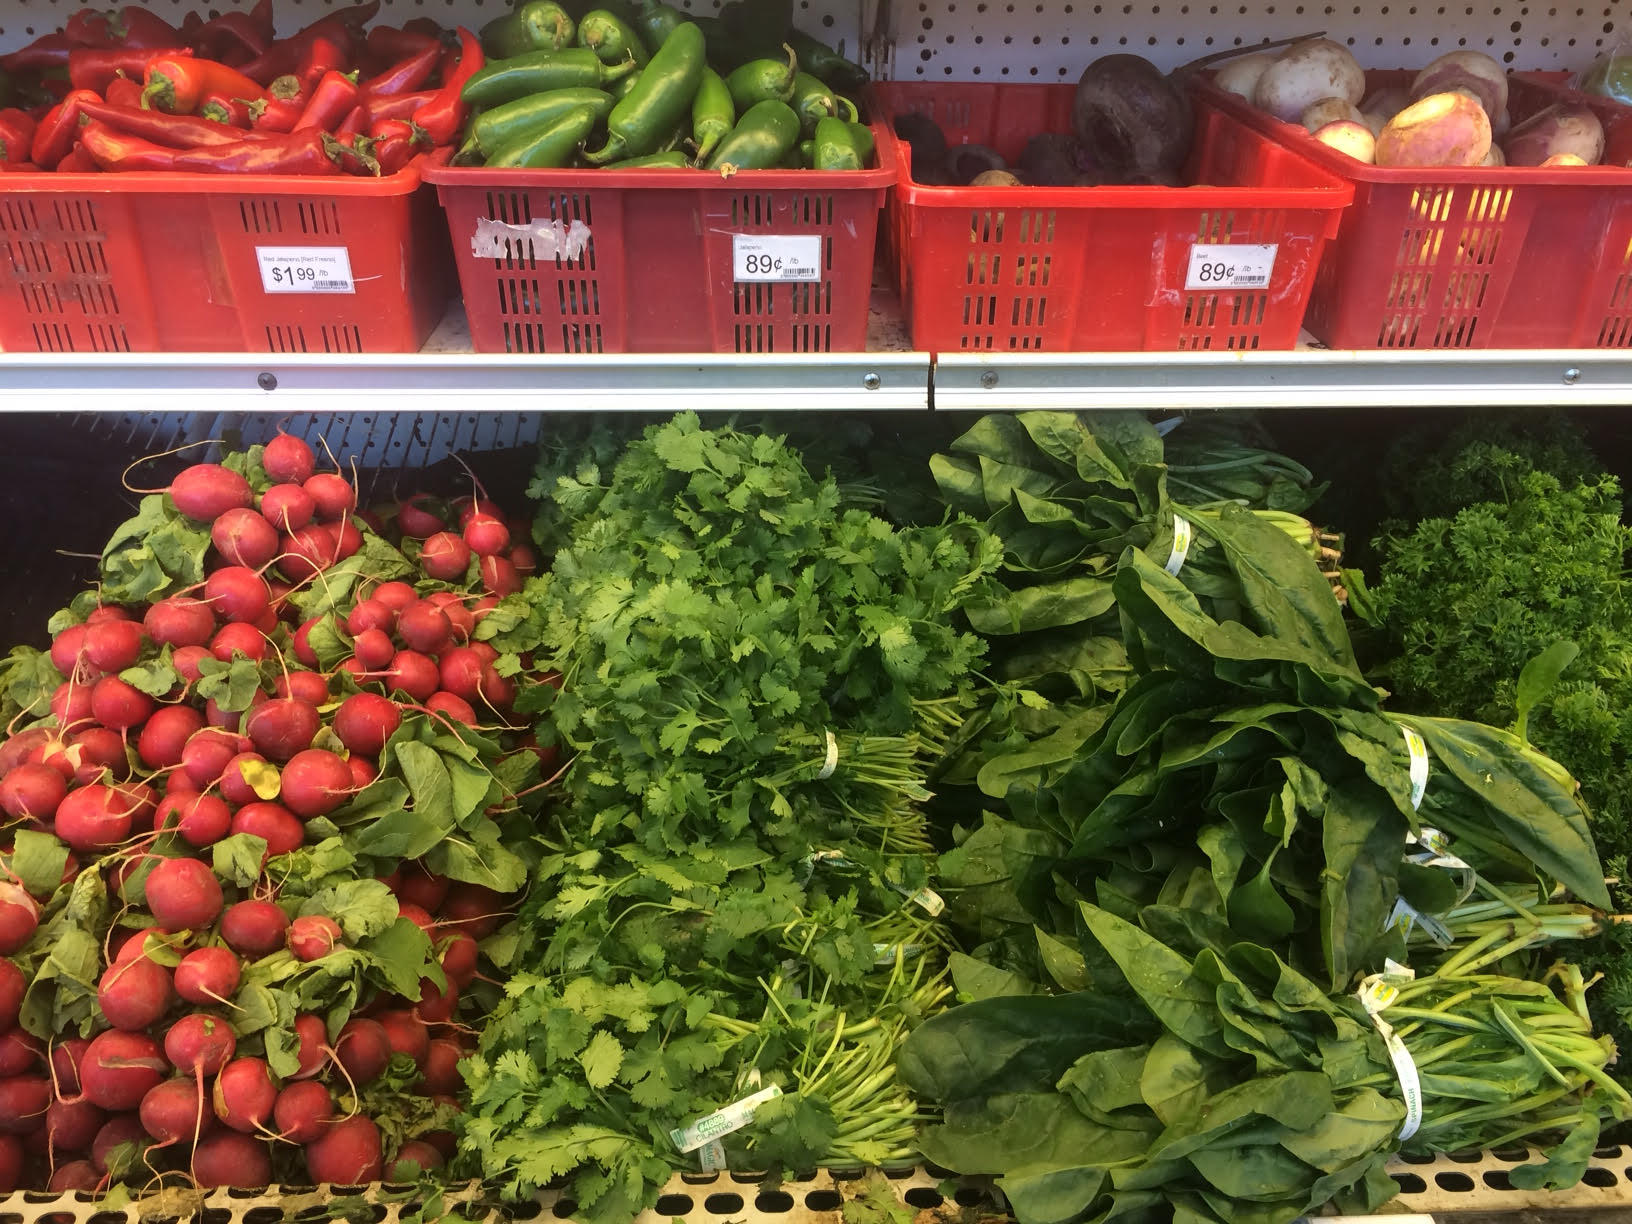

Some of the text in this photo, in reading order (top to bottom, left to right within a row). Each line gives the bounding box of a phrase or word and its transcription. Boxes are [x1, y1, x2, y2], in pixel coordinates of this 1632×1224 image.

[746, 254, 783, 273] 89¢
[1199, 263, 1235, 281] 89¢
[1408, 1087, 1417, 1123] SPINACH
[696, 1121, 733, 1142] CILANTRO
